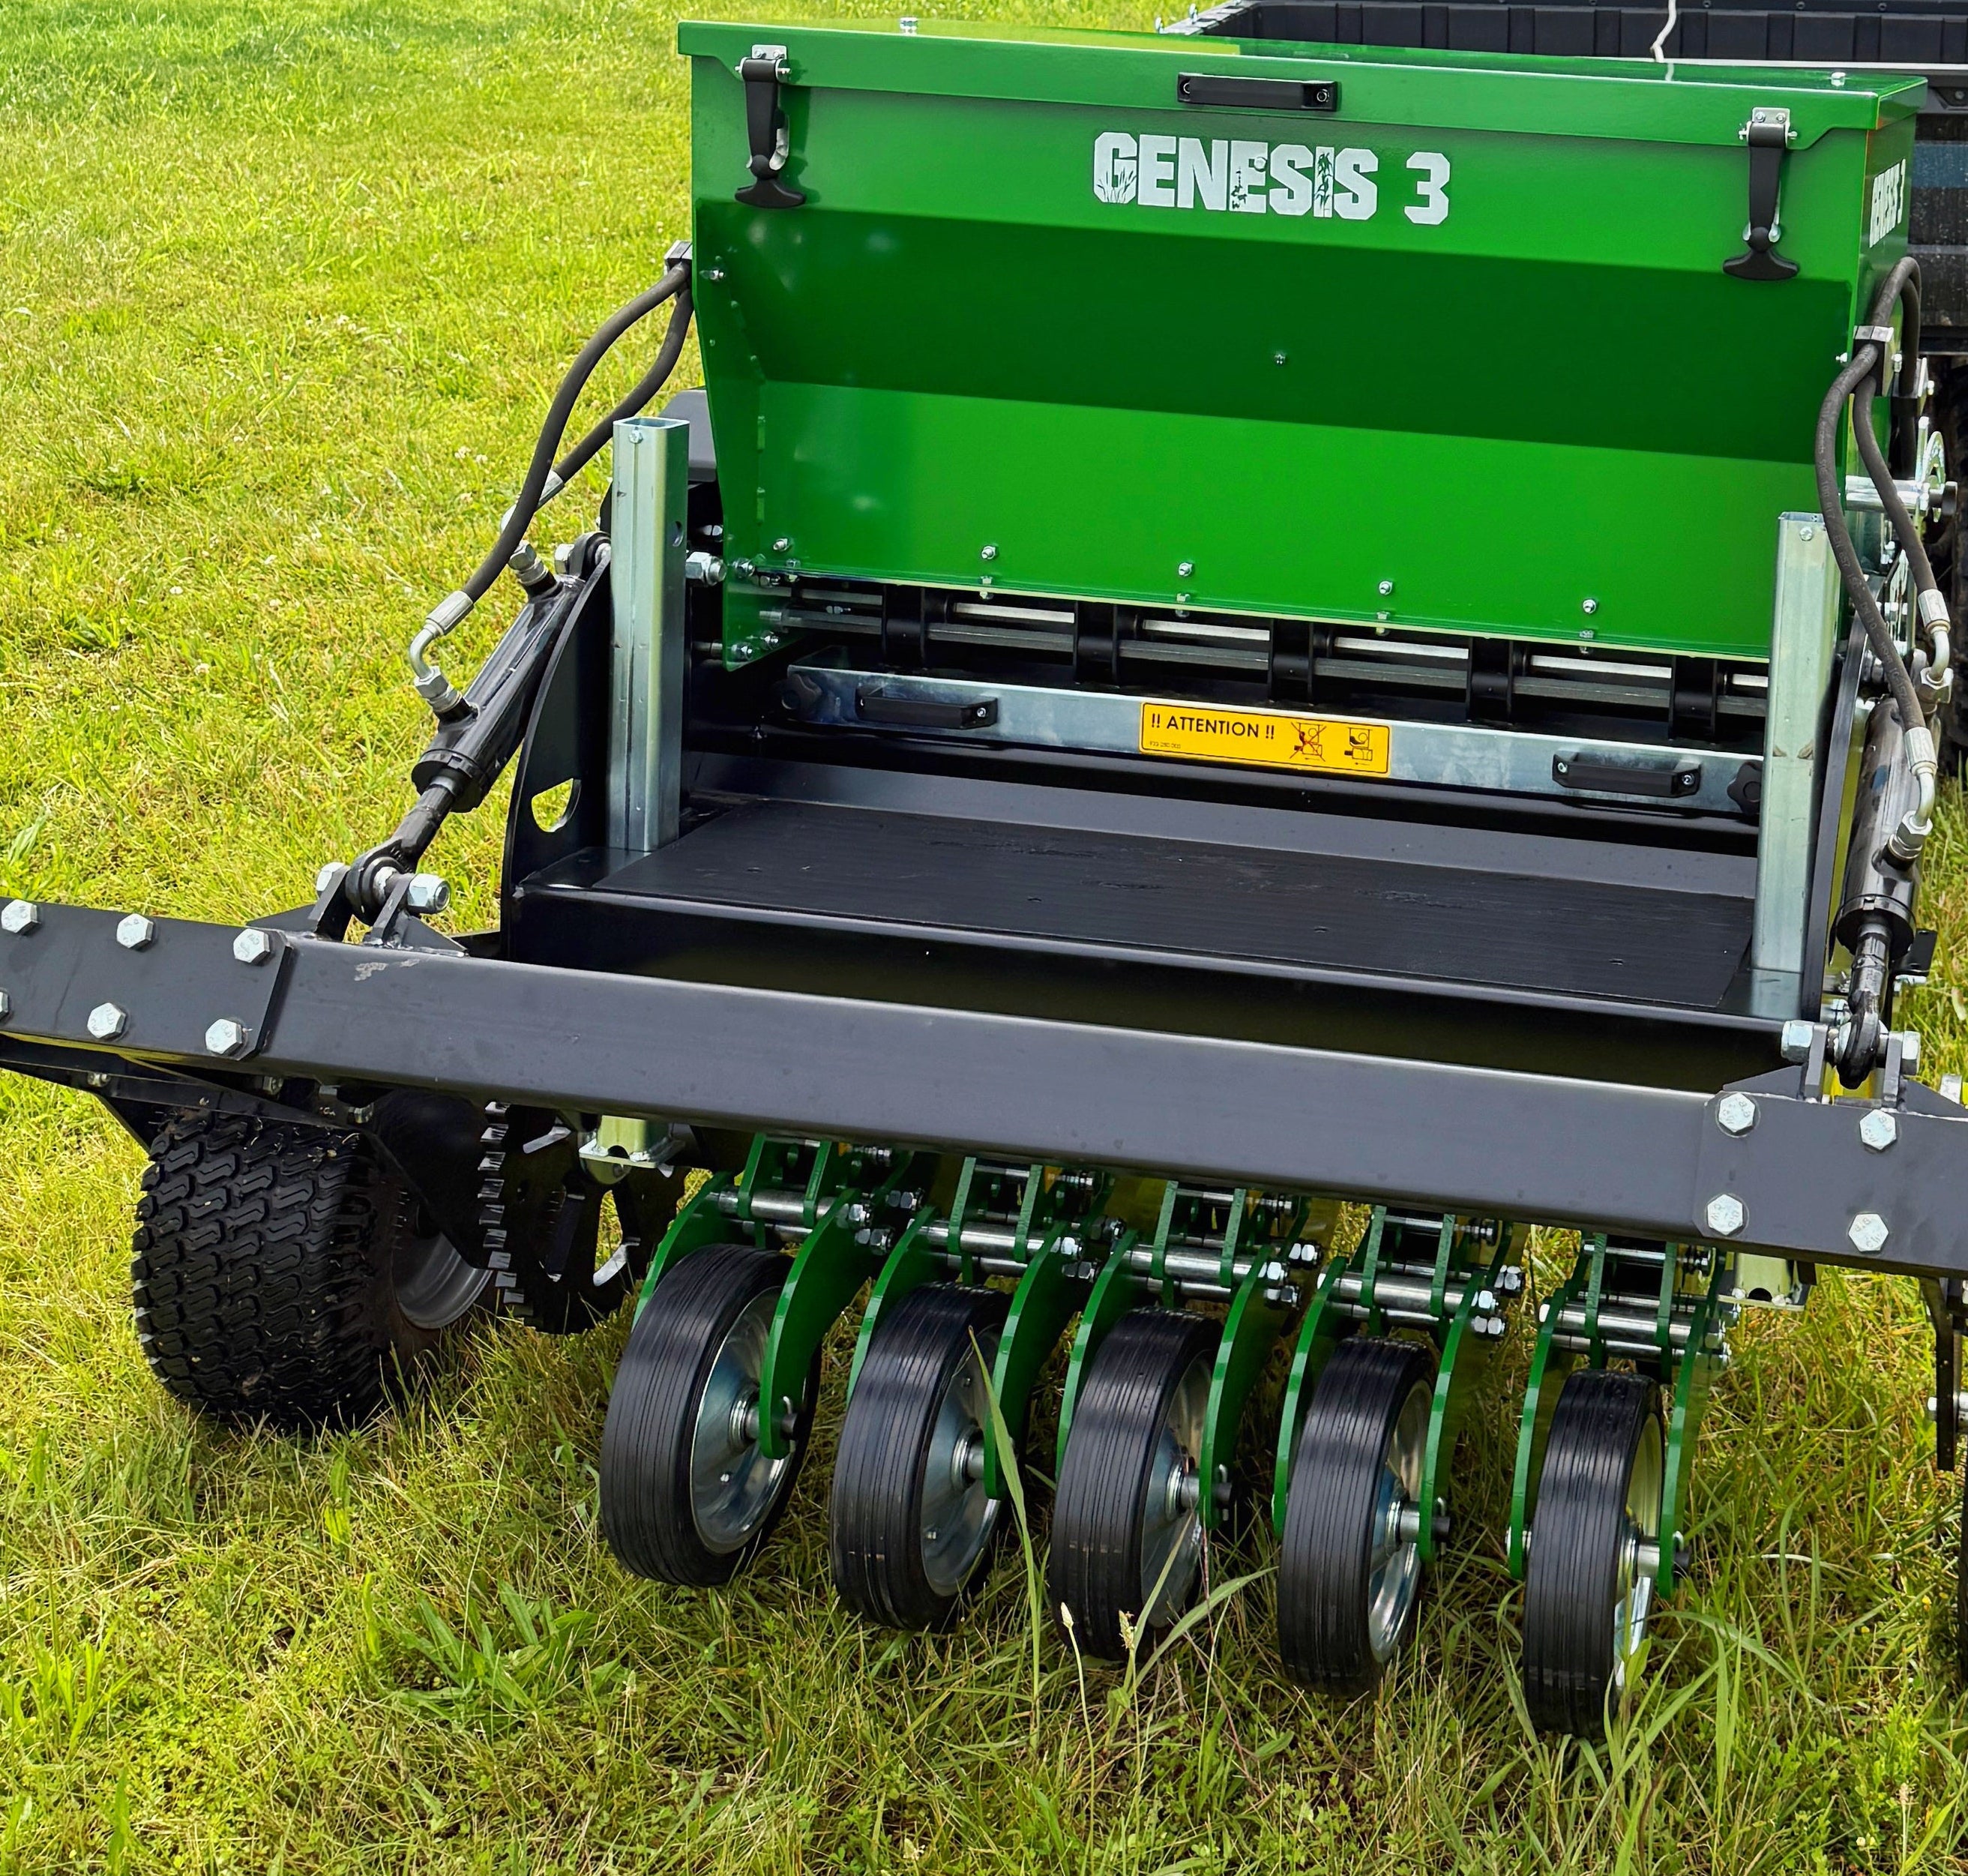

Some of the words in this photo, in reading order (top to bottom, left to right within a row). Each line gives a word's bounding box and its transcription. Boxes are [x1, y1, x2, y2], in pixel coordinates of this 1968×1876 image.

[1094, 131, 1379, 220] GENESIS
[1403, 151, 1451, 225] 3
[1151, 713, 1161, 727] !!
[1167, 715, 1259, 739] ATTENTION
[1266, 725, 1275, 739] !!
